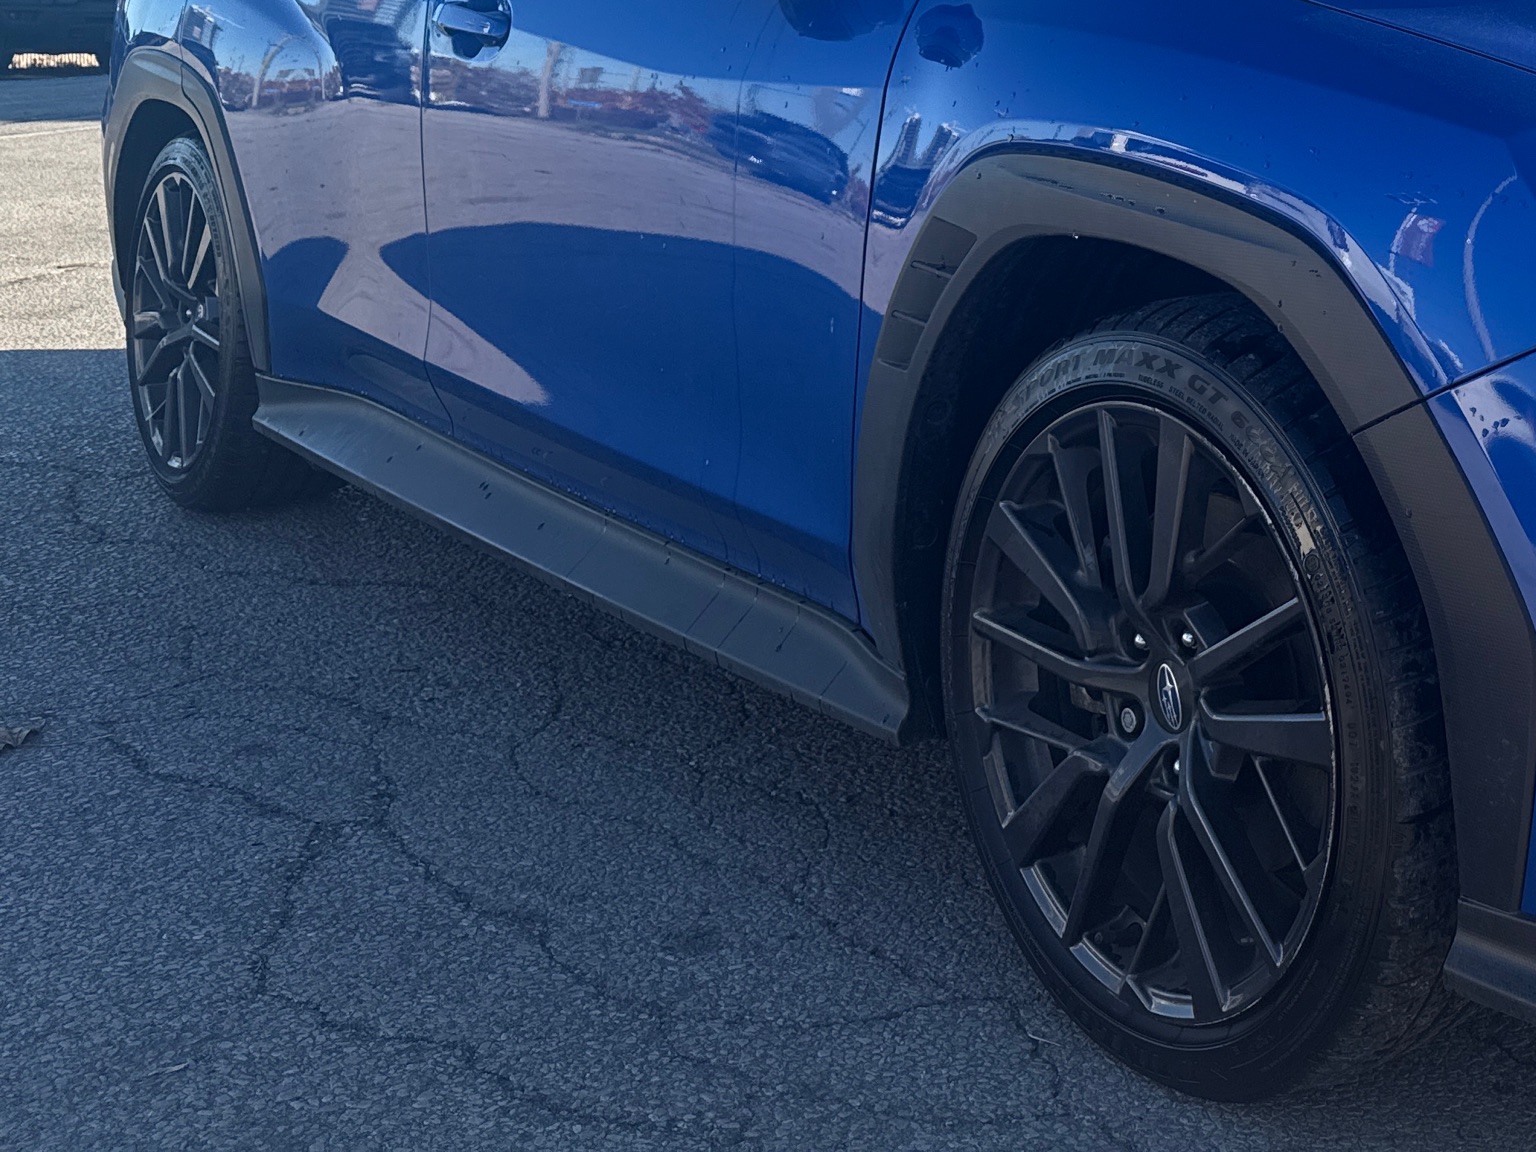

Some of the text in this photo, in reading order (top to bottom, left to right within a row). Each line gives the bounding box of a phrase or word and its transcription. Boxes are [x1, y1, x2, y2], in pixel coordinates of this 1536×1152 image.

[1092, 348, 1183, 379] MAXX
[1187, 374, 1229, 405] GT
[1169, 385, 1185, 401] STEEL
[1185, 395, 1207, 417] BELTED
